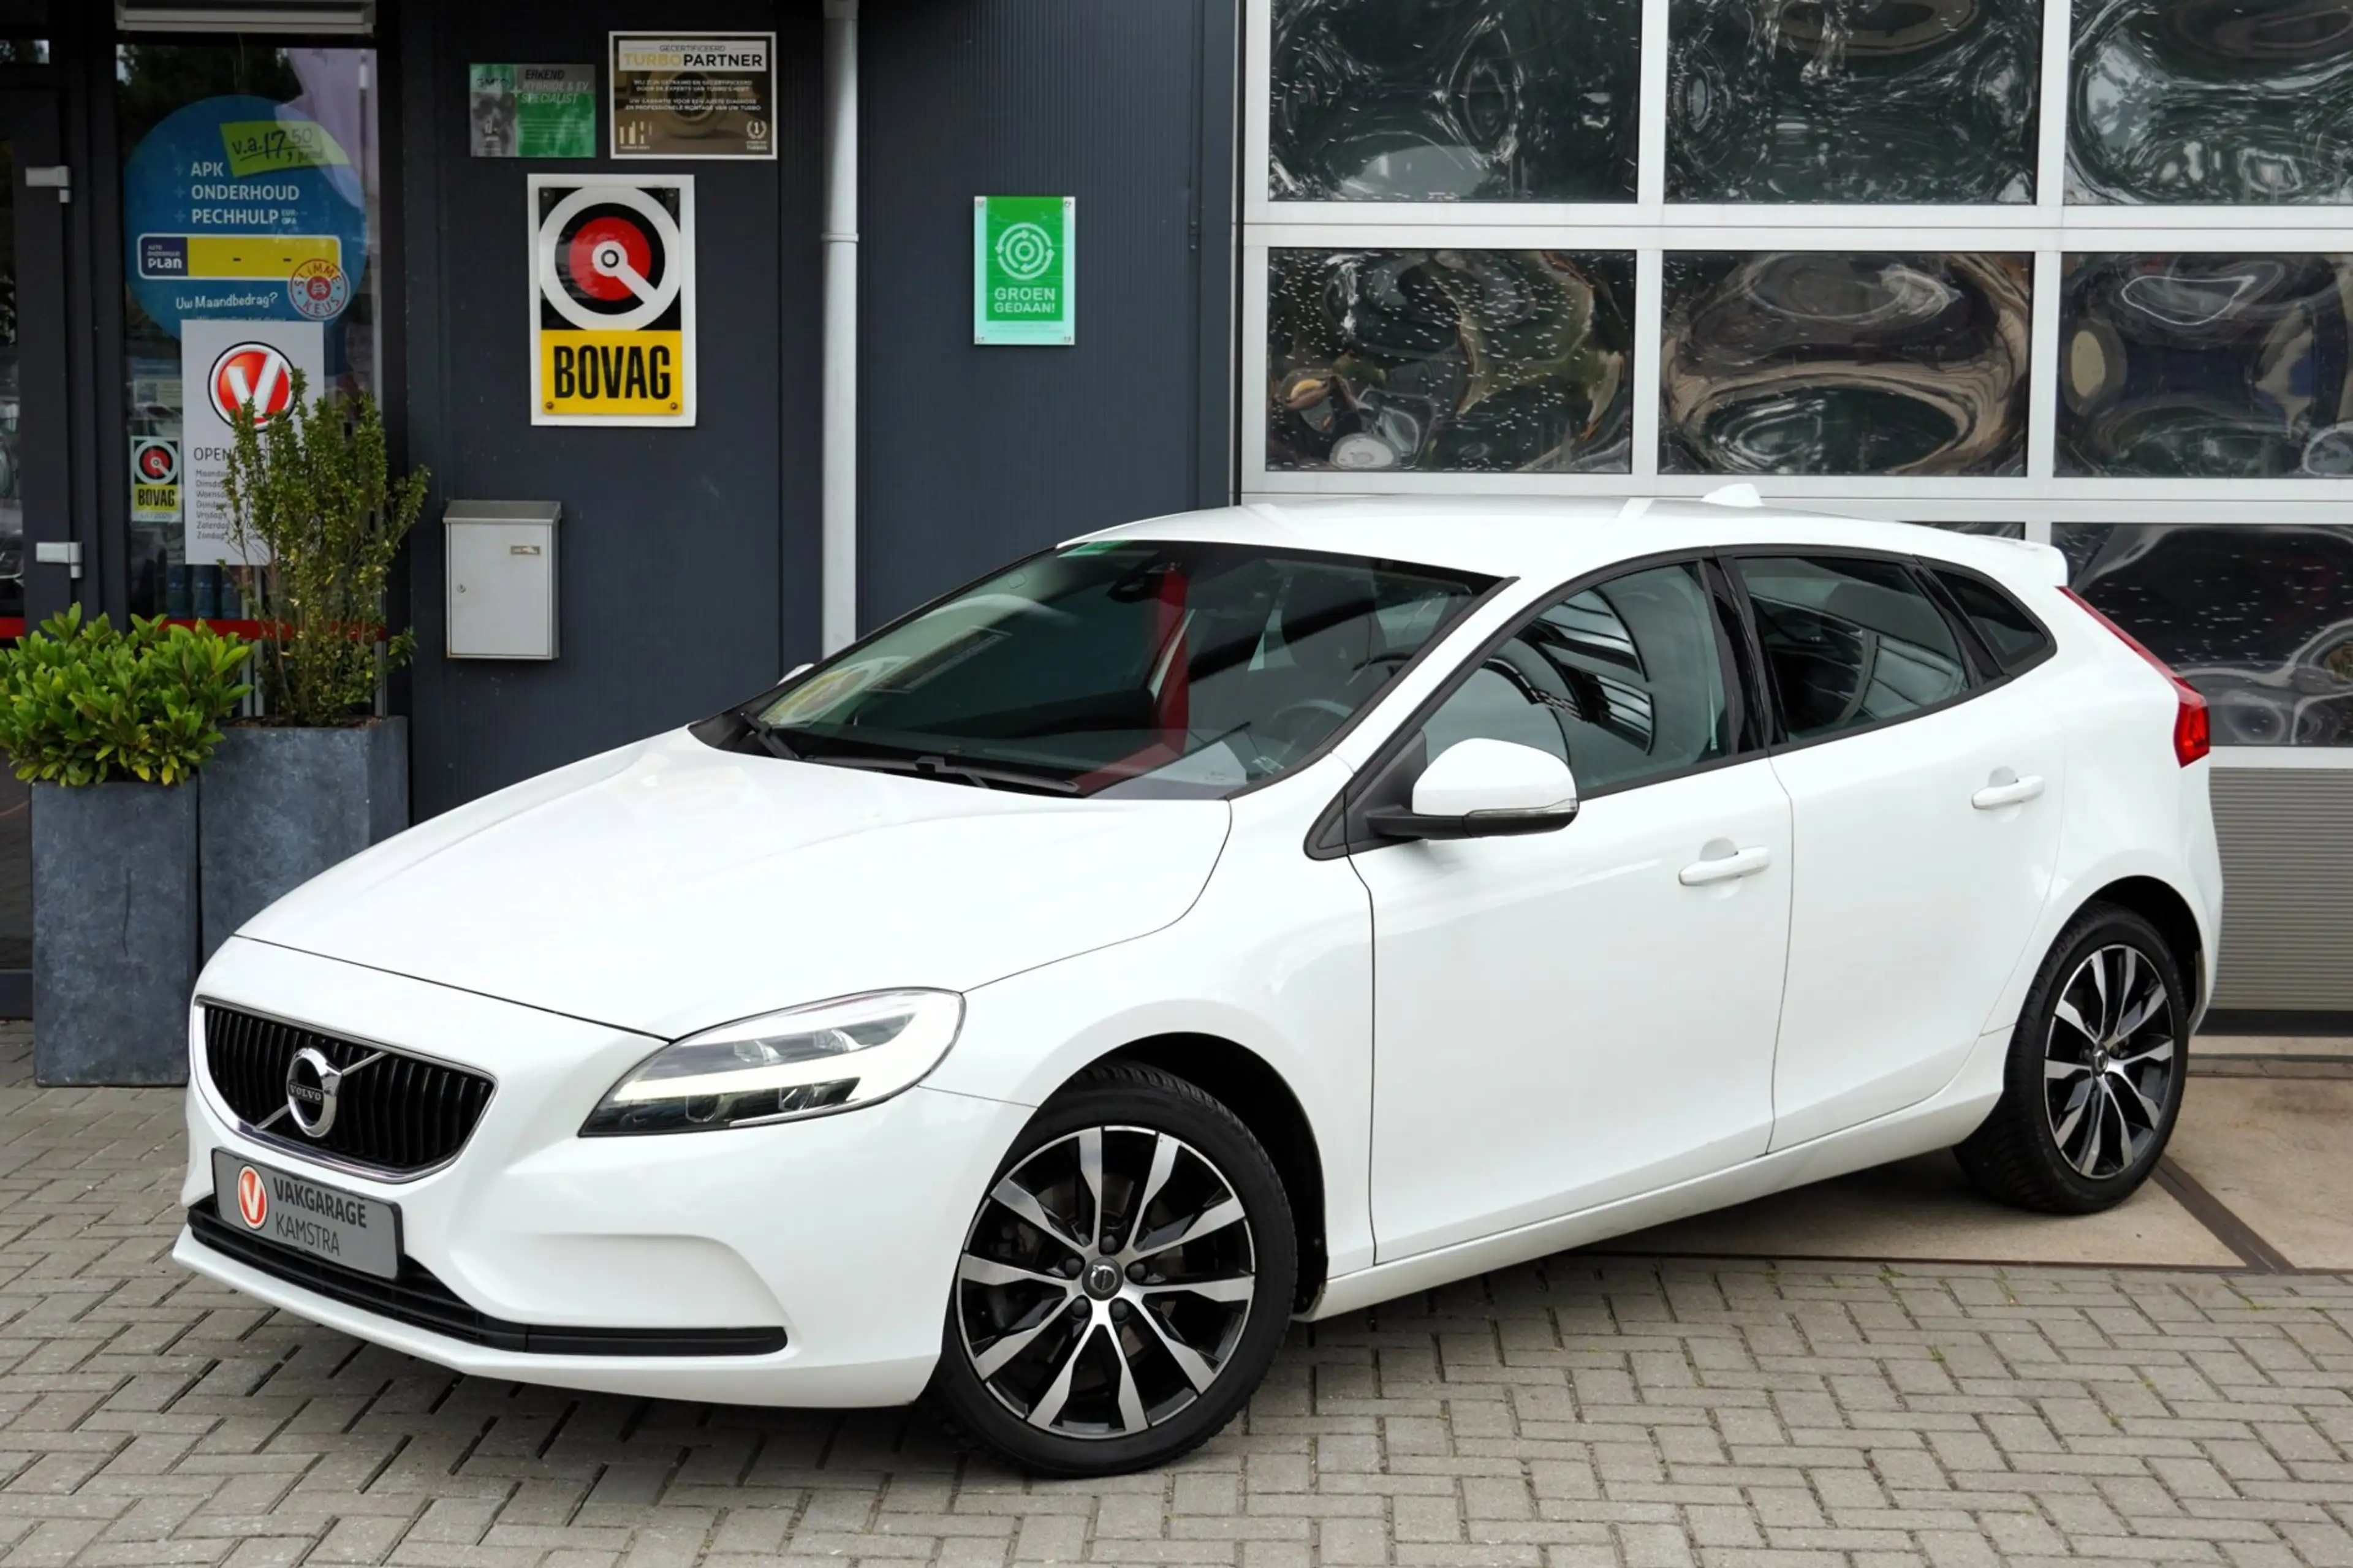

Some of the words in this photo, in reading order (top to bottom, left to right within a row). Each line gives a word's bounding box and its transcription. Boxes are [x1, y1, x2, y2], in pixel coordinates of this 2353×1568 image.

[525, 69, 566, 80] ERKEND
[191, 161, 224, 178] APK
[191, 185, 300, 201] ONDERHOUD
[191, 208, 279, 224] PECHHULP
[176, 297, 192, 309] Uw
[194, 292, 279, 309] Maandbedrag?
[994, 287, 1055, 301] GROEN
[994, 302, 1055, 313] GEDAAN!
[553, 344, 671, 400] BOVAG
[137, 488, 175, 507] BOVAG
[289, 1084, 322, 1101] VOLVO
[273, 1176, 367, 1229] VAKGARAGE
[276, 1211, 340, 1256] KAMSTRA
